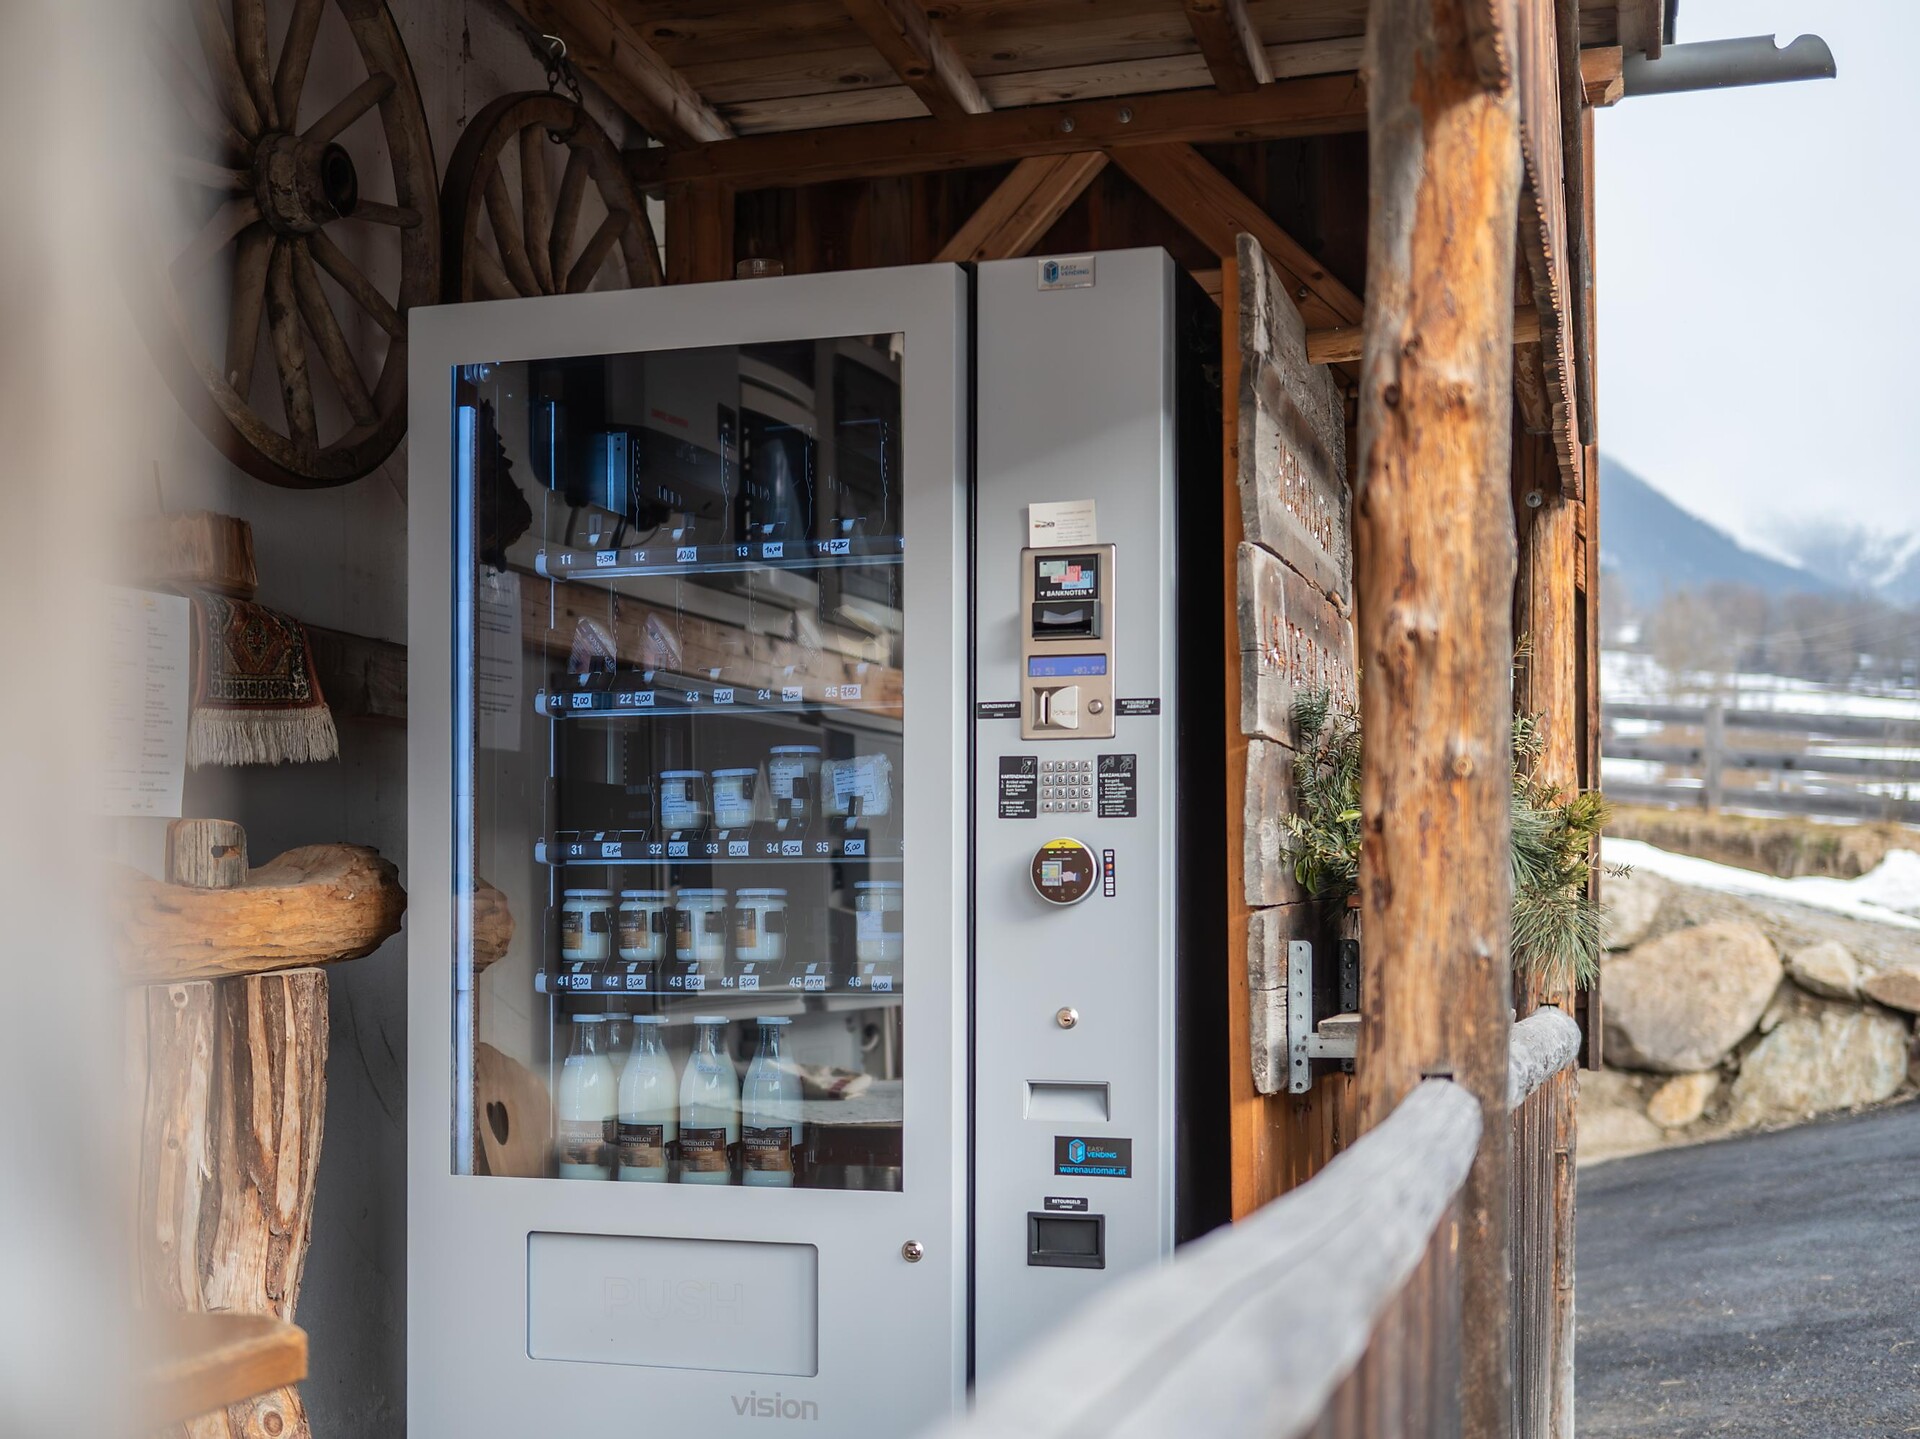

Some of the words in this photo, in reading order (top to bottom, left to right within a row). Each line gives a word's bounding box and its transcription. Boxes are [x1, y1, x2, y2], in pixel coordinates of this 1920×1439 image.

[1060, 268, 1089, 276] VENDING
[736, 547, 748, 557] 13
[817, 542, 829, 552] 14
[560, 554, 572, 565] 11
[634, 551, 646, 562] 12
[686, 692, 699, 701] 23
[714, 691, 731, 703] 7,00
[758, 689, 771, 700] 24
[825, 687, 837, 697] 25
[551, 695, 562, 706] 21
[620, 694, 632, 704] 22
[571, 844, 582, 855] 31
[650, 843, 662, 854] 32
[706, 843, 719, 854] 33
[766, 843, 779, 853] 34
[782, 845, 800, 855] 6,50
[816, 842, 829, 853] 35
[557, 976, 569, 987] 41
[572, 978, 589, 988] 3,00
[606, 976, 619, 987] 42
[627, 978, 643, 988] 3,00
[669, 976, 682, 987] 43
[686, 978, 701, 988] 3,00
[720, 977, 734, 987] 44
[740, 978, 756, 987] 3,00
[789, 977, 801, 988] 45
[848, 976, 862, 988] 46
[1059, 1166, 1127, 1176] warenautomat.at
[603, 1276, 743, 1324] PUSH
[731, 1390, 819, 1421] vision
